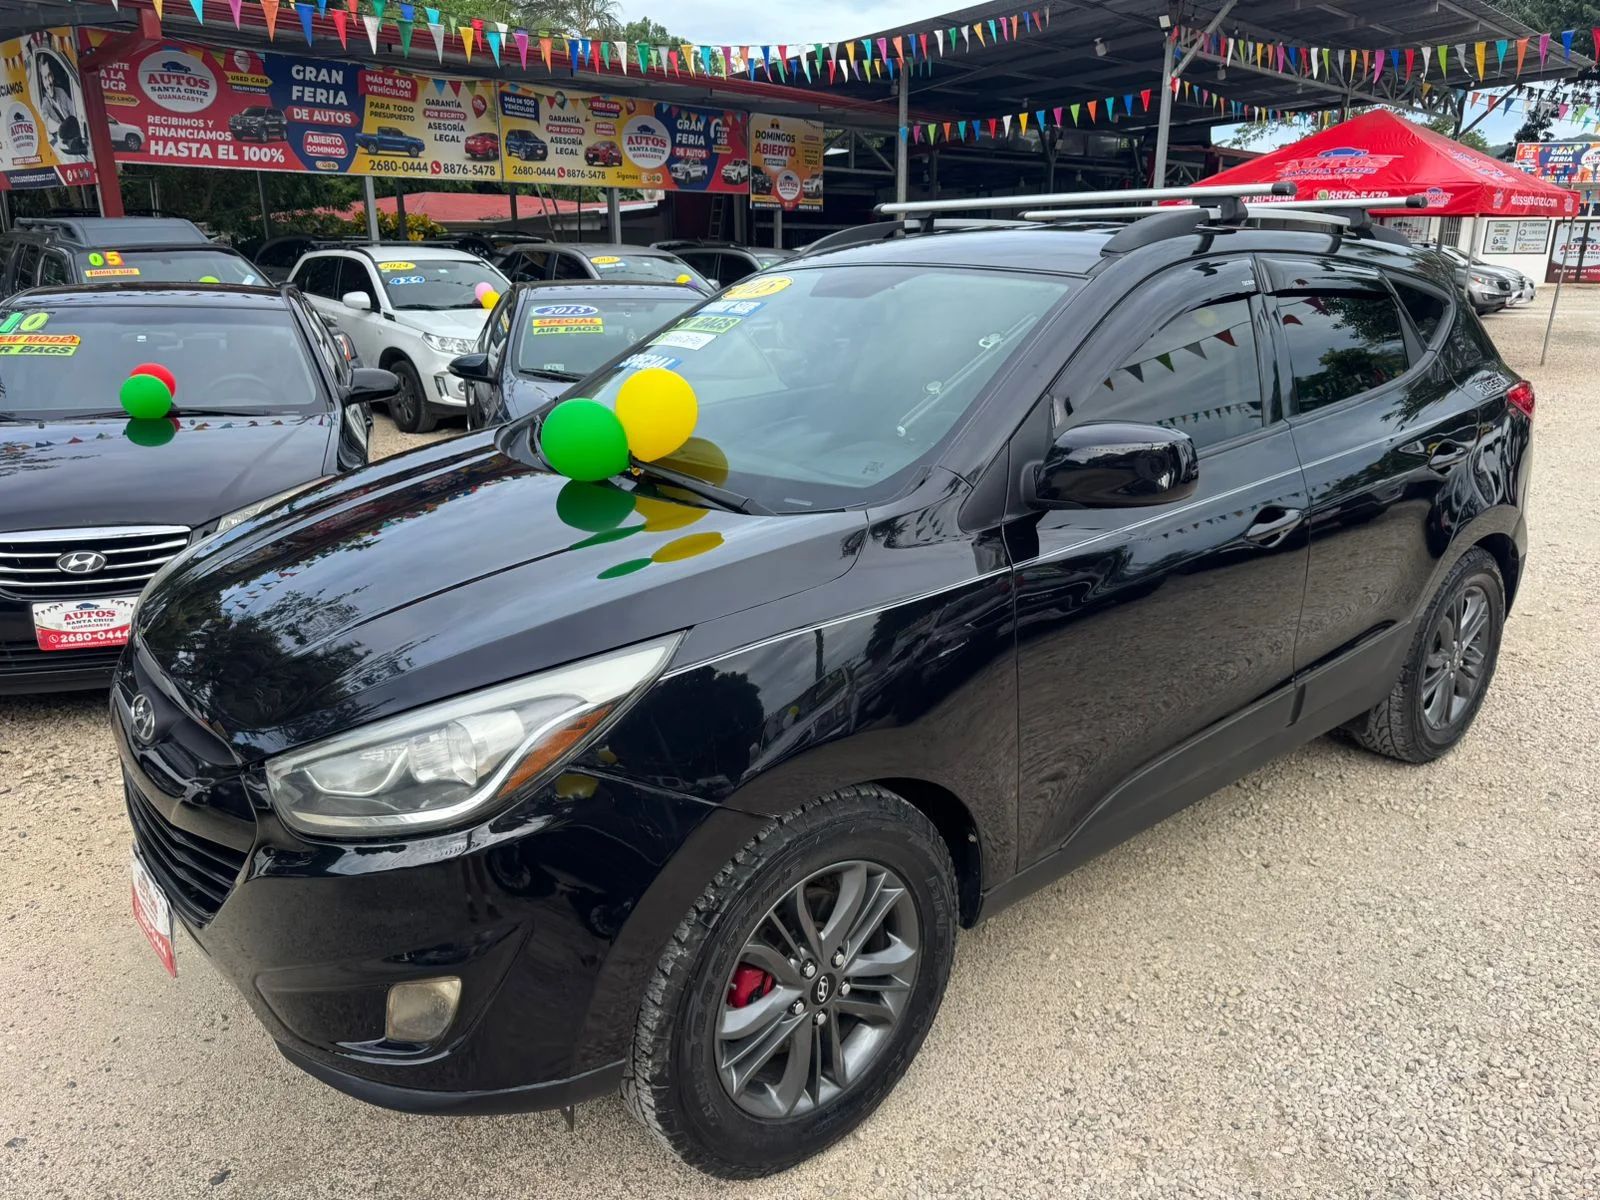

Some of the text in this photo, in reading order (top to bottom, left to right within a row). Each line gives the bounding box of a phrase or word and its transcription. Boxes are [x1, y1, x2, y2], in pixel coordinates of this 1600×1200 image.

[110, 70, 124, 80] LA
[291, 65, 344, 85] GRAN
[102, 80, 126, 91] UCR
[147, 73, 210, 91] AUTOS
[250, 77, 268, 85] CARS
[384, 78, 393, 86] DE
[396, 79, 412, 89] 100
[151, 86, 208, 98] SANTA CRUZ
[292, 86, 348, 106] FERIA
[368, 85, 411, 98] VEHÍCULOS!
[157, 94, 204, 104] GUANACASTE
[425, 98, 462, 109] GARANTÍA
[369, 101, 414, 113] PARA TODO
[293, 108, 352, 124] DE AUTOS
[370, 111, 415, 122] PRESUPUESTO
[440, 112, 465, 120] ESCRITO
[548, 115, 581, 124] GARANTÍA
[147, 116, 214, 128] RECIBIMOS Y
[427, 122, 466, 133] ASESORÍA
[677, 119, 704, 132] GRAN
[11, 123, 34, 138] AUTOS
[148, 126, 232, 141] FINANCIAMOS
[307, 135, 342, 146] ABIERTO
[434, 134, 461, 143] LEGAL
[550, 135, 583, 146] ASESORÍA
[627, 136, 667, 148] AUTOS
[676, 133, 705, 146] FERIA
[755, 130, 796, 143] DOMINGOS
[149, 141, 285, 163] HASTA EL 100%
[306, 145, 345, 156] DOMINGOS
[555, 148, 579, 156] LEGAL
[687, 149, 706, 158] AUTOS
[754, 143, 796, 157] ABIERTO
[369, 159, 428, 173] 2680-0444
[443, 163, 496, 176] 8876-5478
[513, 165, 556, 178] 2680-0444
[567, 169, 606, 180] 8876-5478
[545, 306, 586, 315] 2015
[0, 312, 49, 333] 10
[537, 318, 598, 326] SPECIAL
[24, 336, 78, 344] MODEL
[18, 346, 72, 354] BAGS
[64, 610, 116, 621] AUTOS
[60, 630, 129, 643] 2680-0444
